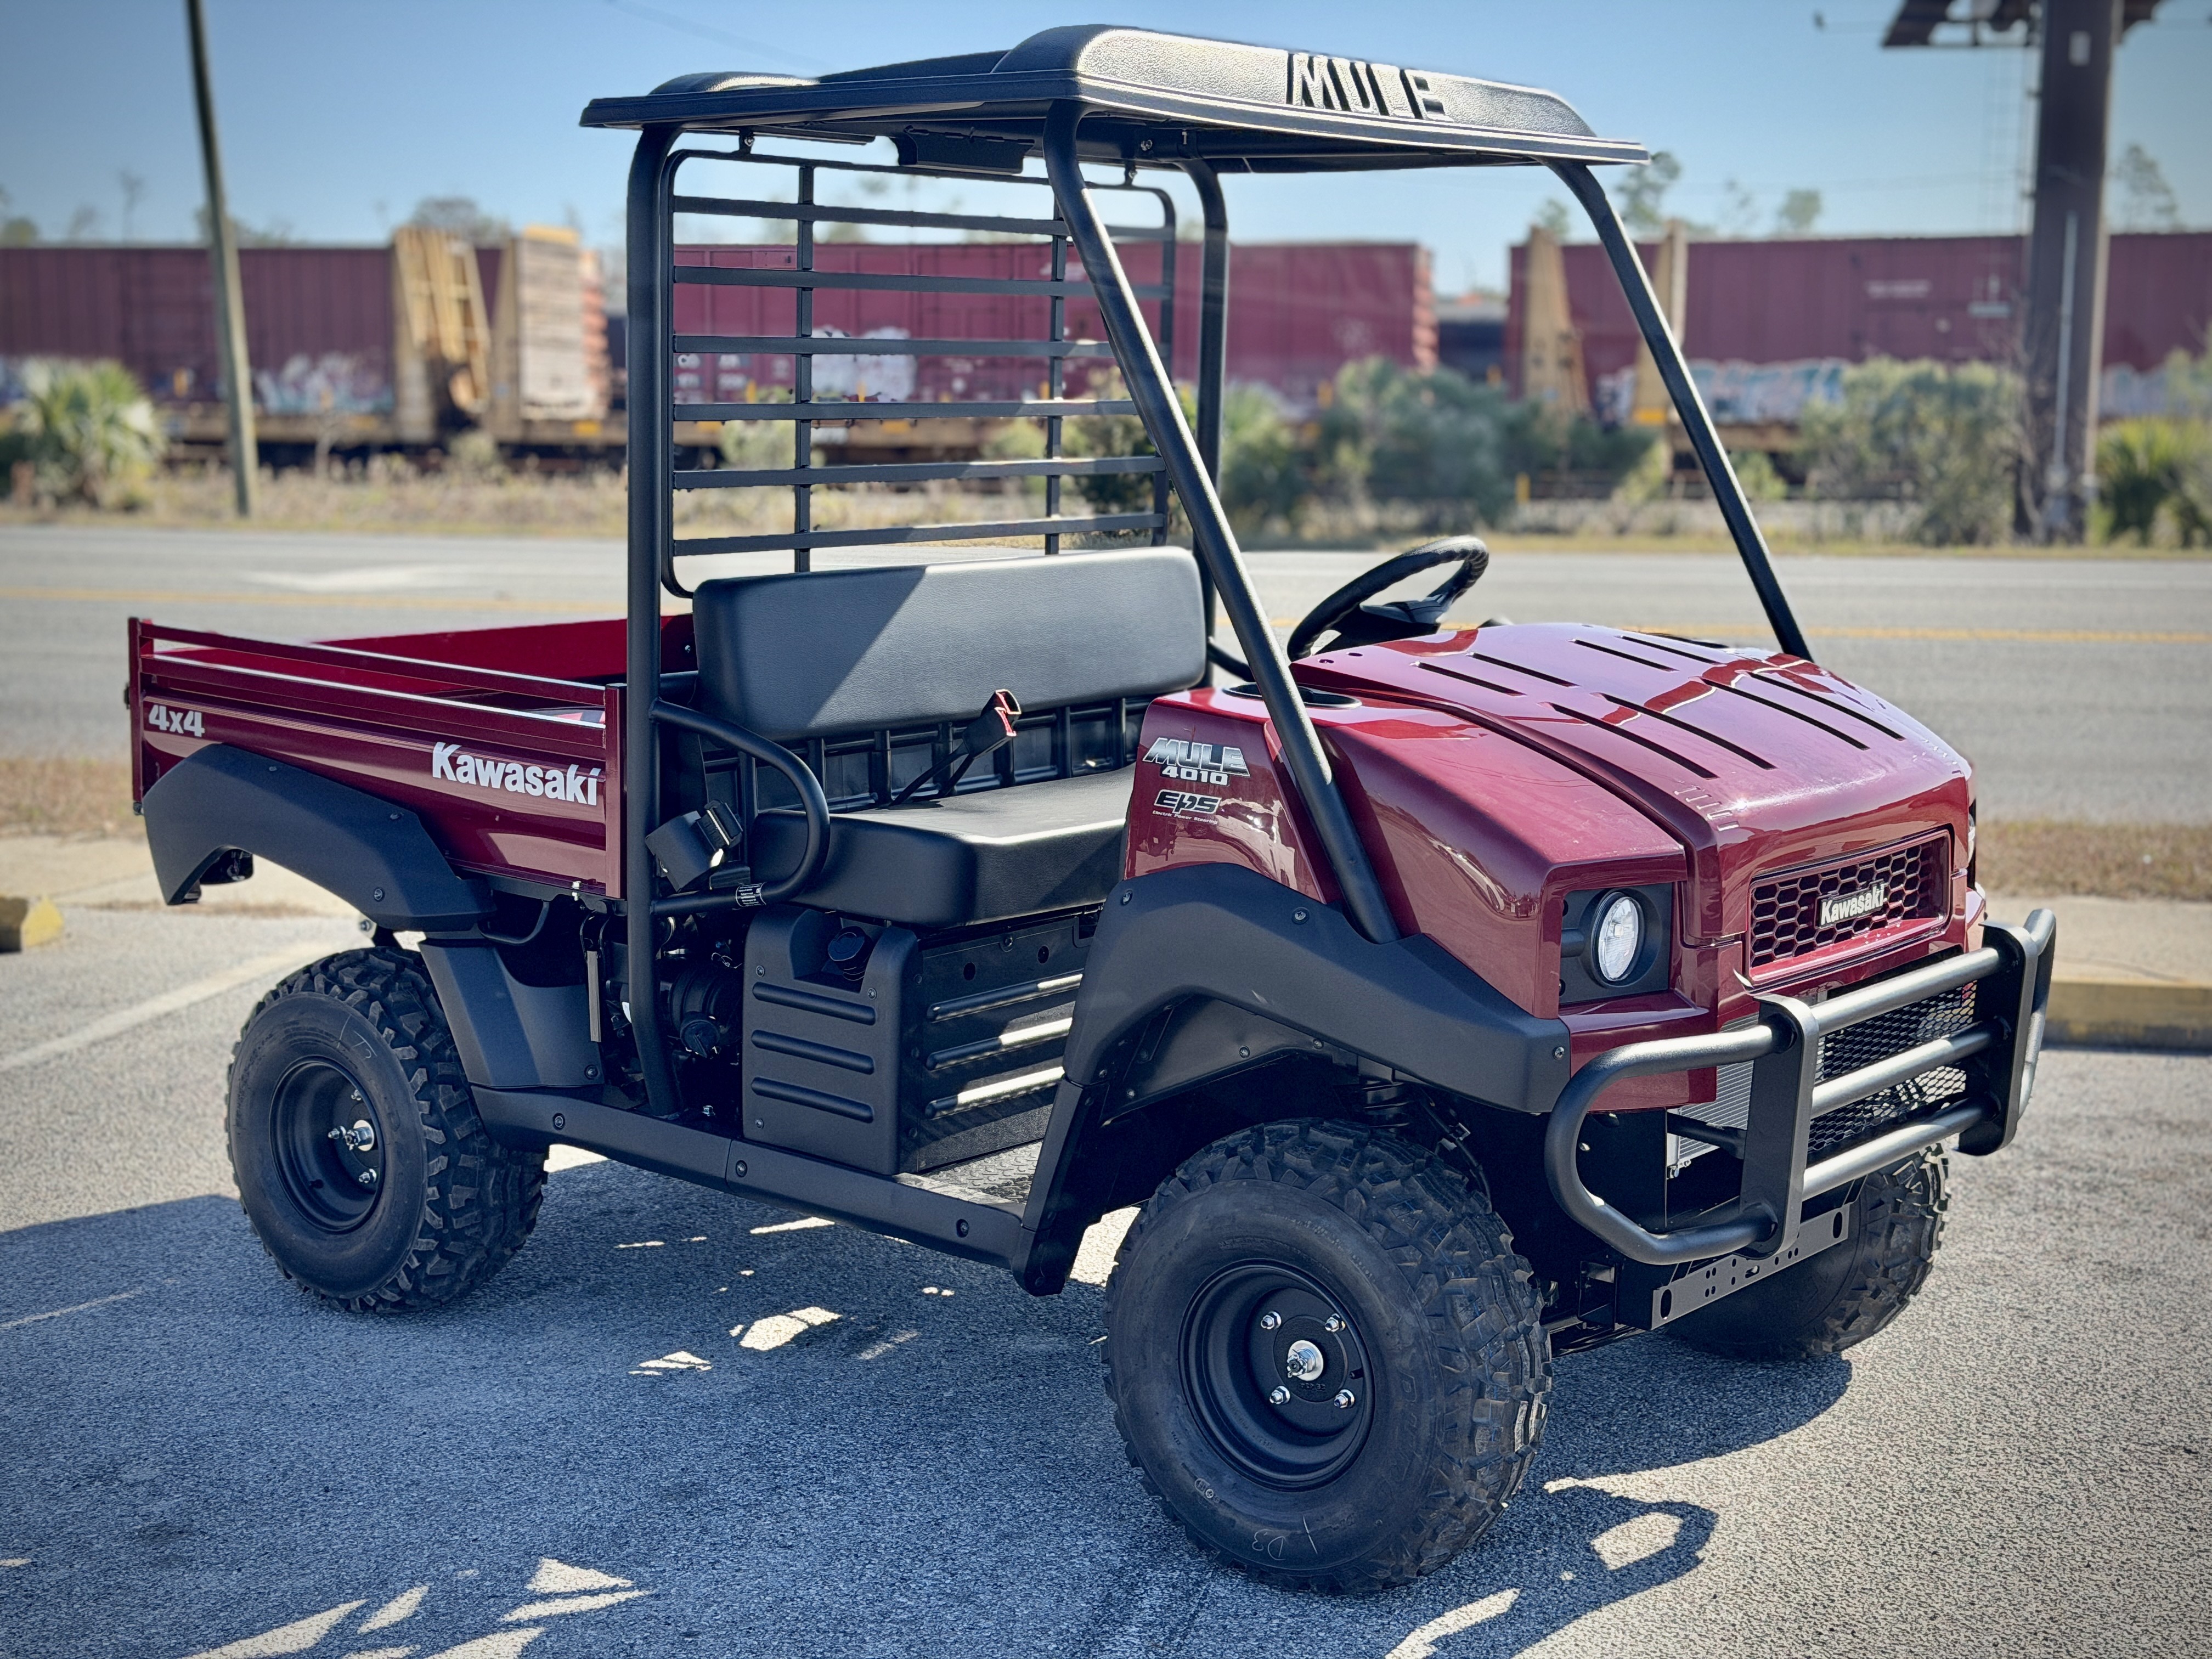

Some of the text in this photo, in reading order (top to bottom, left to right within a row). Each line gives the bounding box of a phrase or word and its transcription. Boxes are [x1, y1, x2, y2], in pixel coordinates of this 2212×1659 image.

[149, 704, 205, 737] 4x4
[1142, 737, 1250, 777] MULE
[432, 742, 601, 806] Kawasaki
[1161, 765, 1228, 786] 4010
[1154, 789, 1221, 814] EPS
[1193, 816, 1218, 825] Steering
[1821, 884, 1884, 926] Kawasaki
